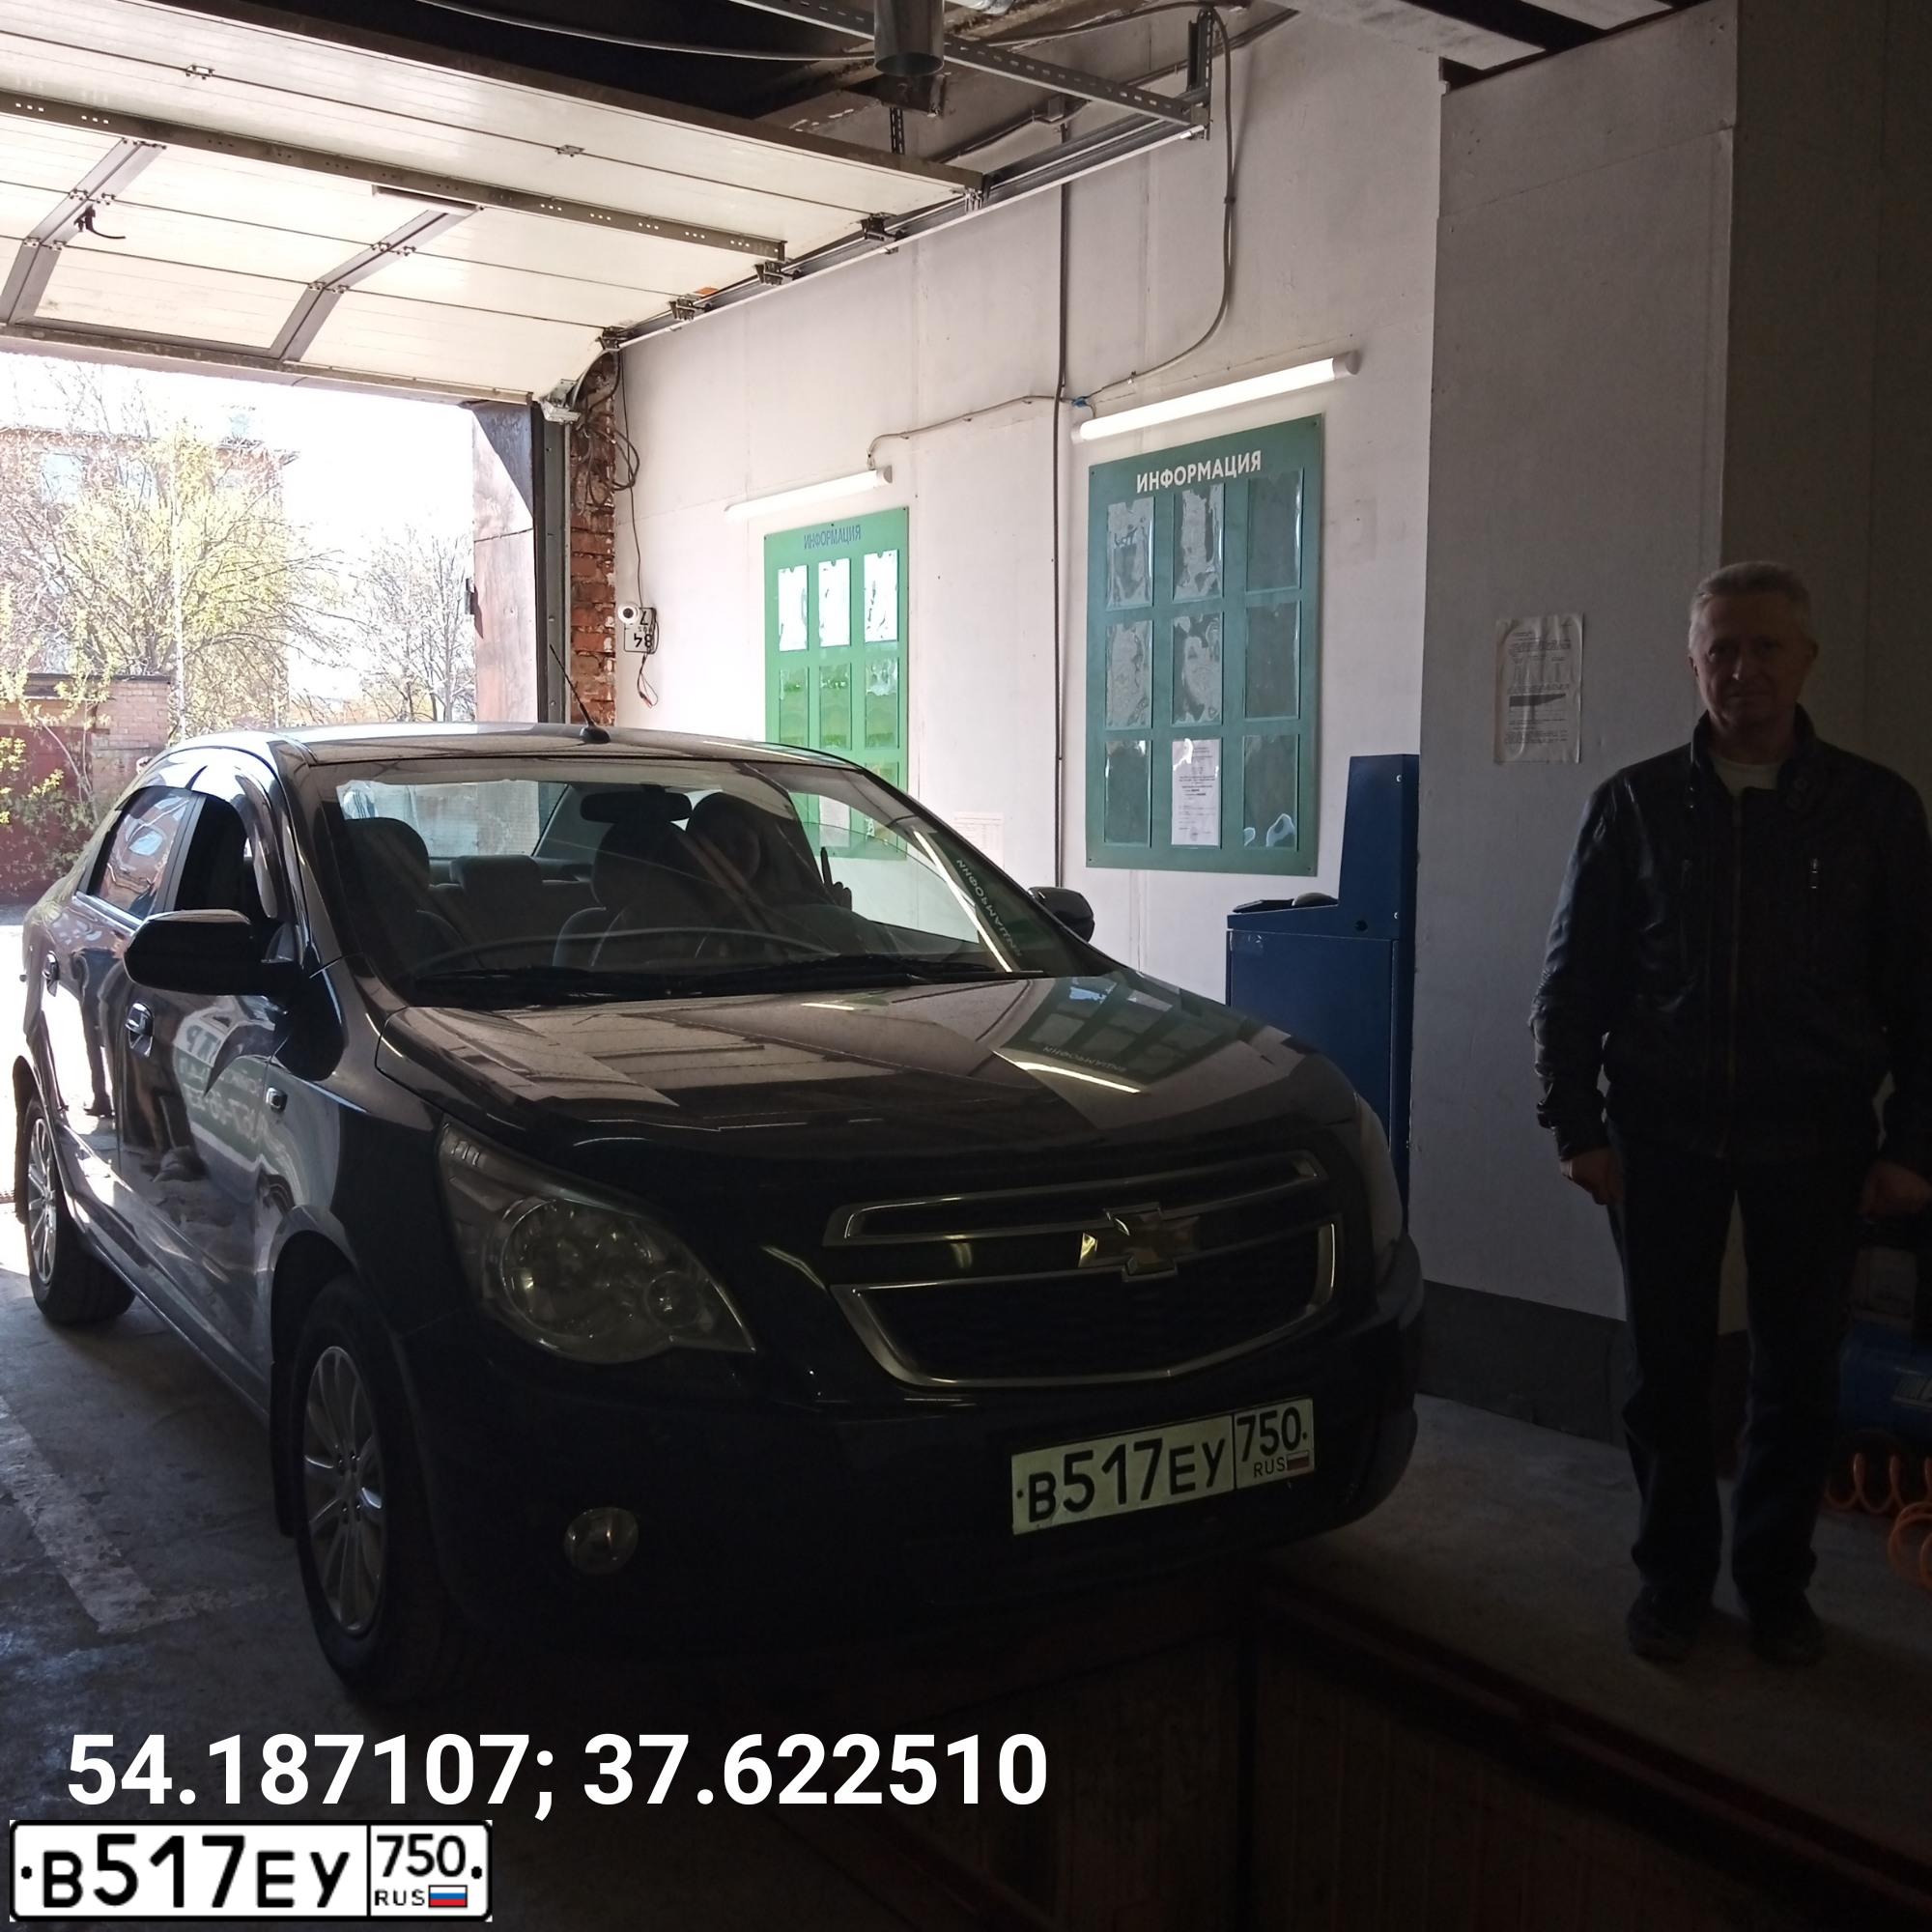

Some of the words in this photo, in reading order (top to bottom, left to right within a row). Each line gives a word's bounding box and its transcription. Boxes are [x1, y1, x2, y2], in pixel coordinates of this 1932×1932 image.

[1135, 450, 1263, 494] ИНФОРМАЦИЯ
[803, 525, 862, 550] ИНФОРМАЦИЯ
[1029, 1438, 1226, 1523] В517ЕУ
[1236, 1406, 1301, 1463] 750
[1253, 1456, 1287, 1478] RUS
